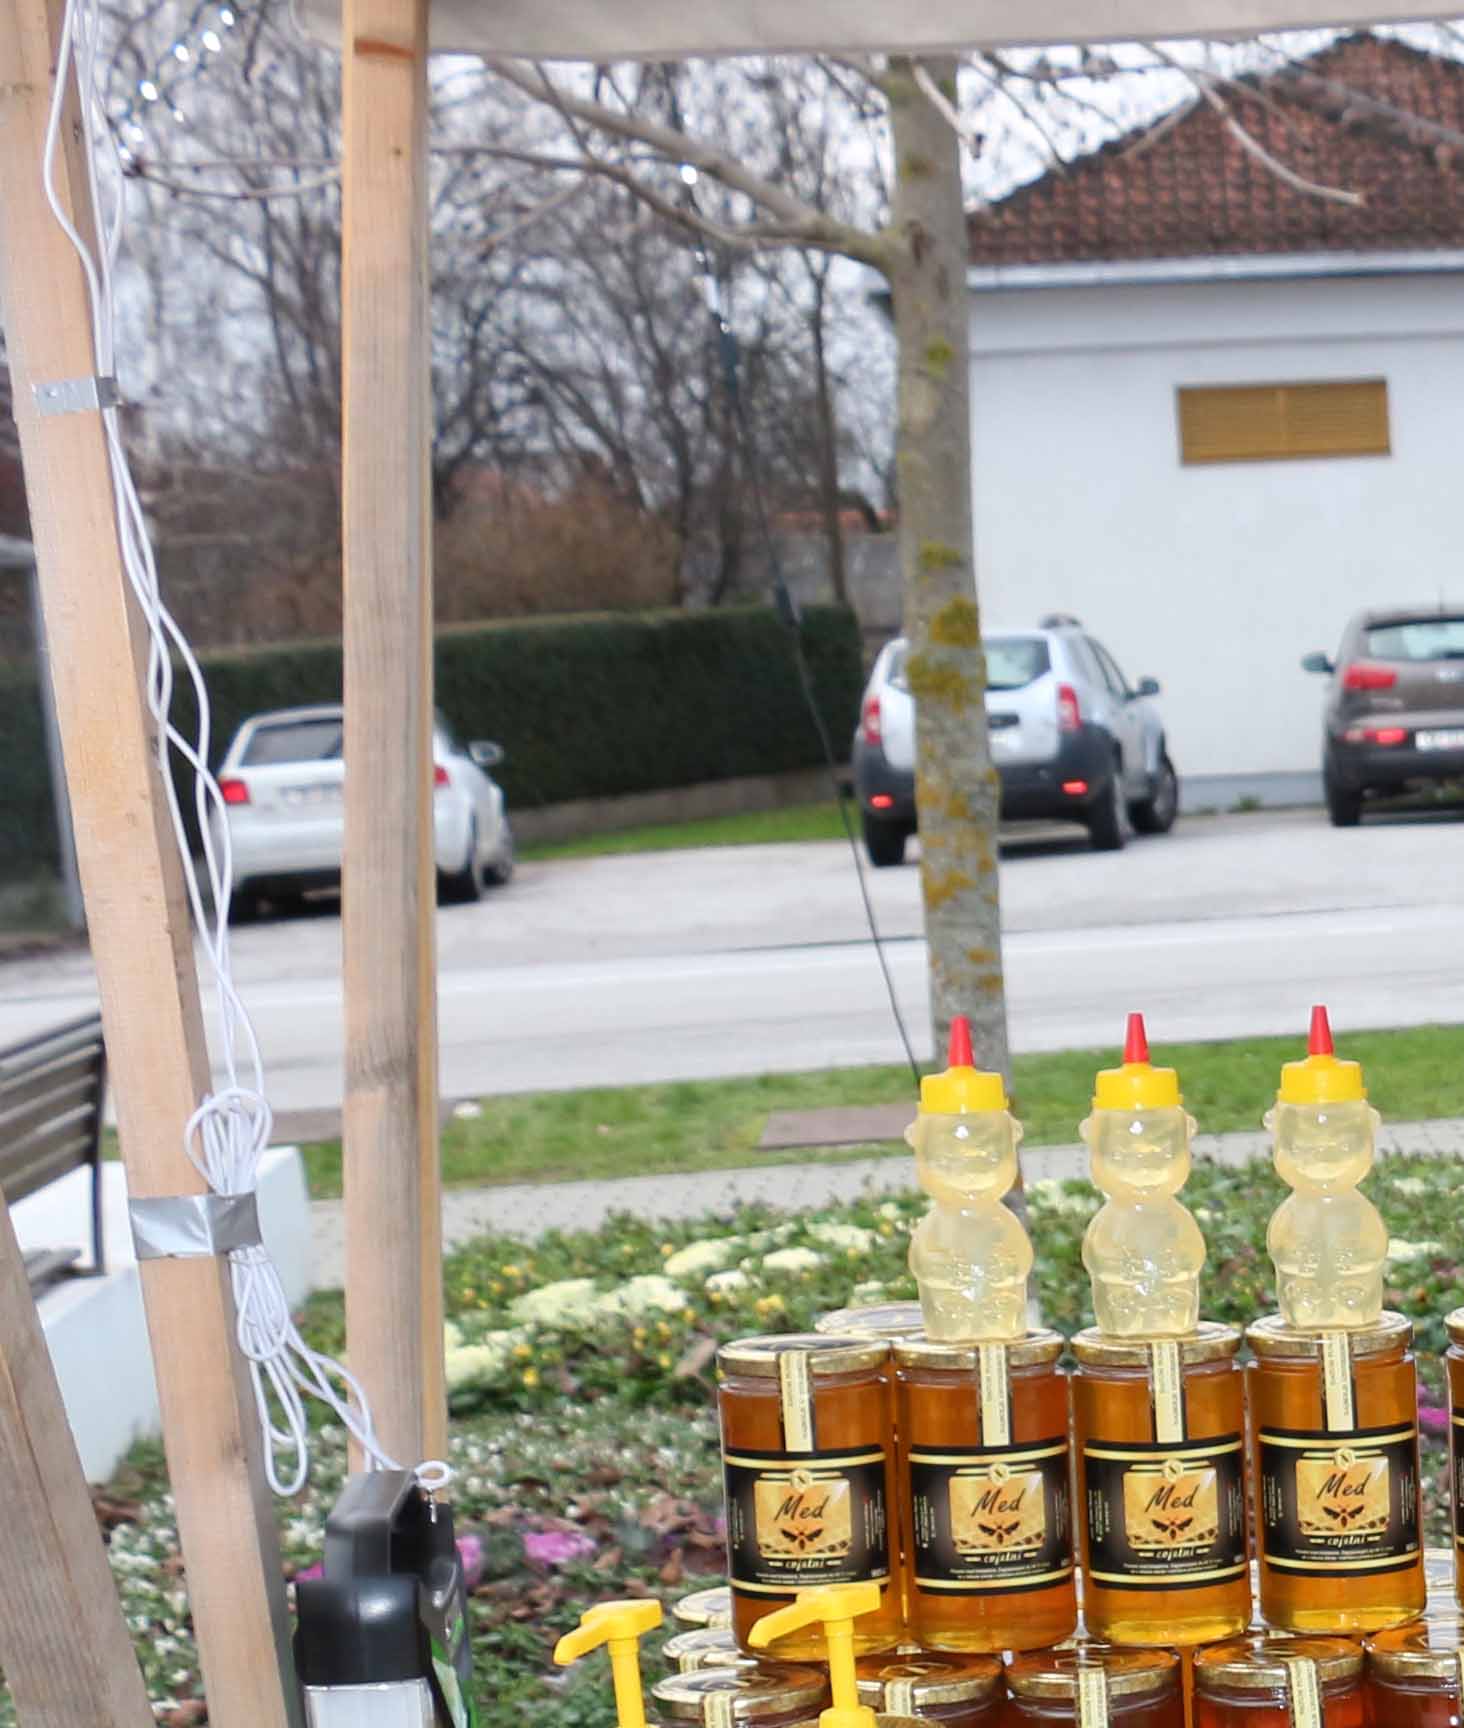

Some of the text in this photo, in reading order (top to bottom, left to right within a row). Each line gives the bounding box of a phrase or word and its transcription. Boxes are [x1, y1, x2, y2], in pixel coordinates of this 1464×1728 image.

[1144, 1482, 1198, 1513] Med
[1316, 1470, 1369, 1500] Med
[774, 1494, 831, 1521] Med
[971, 1487, 1027, 1518] Med
